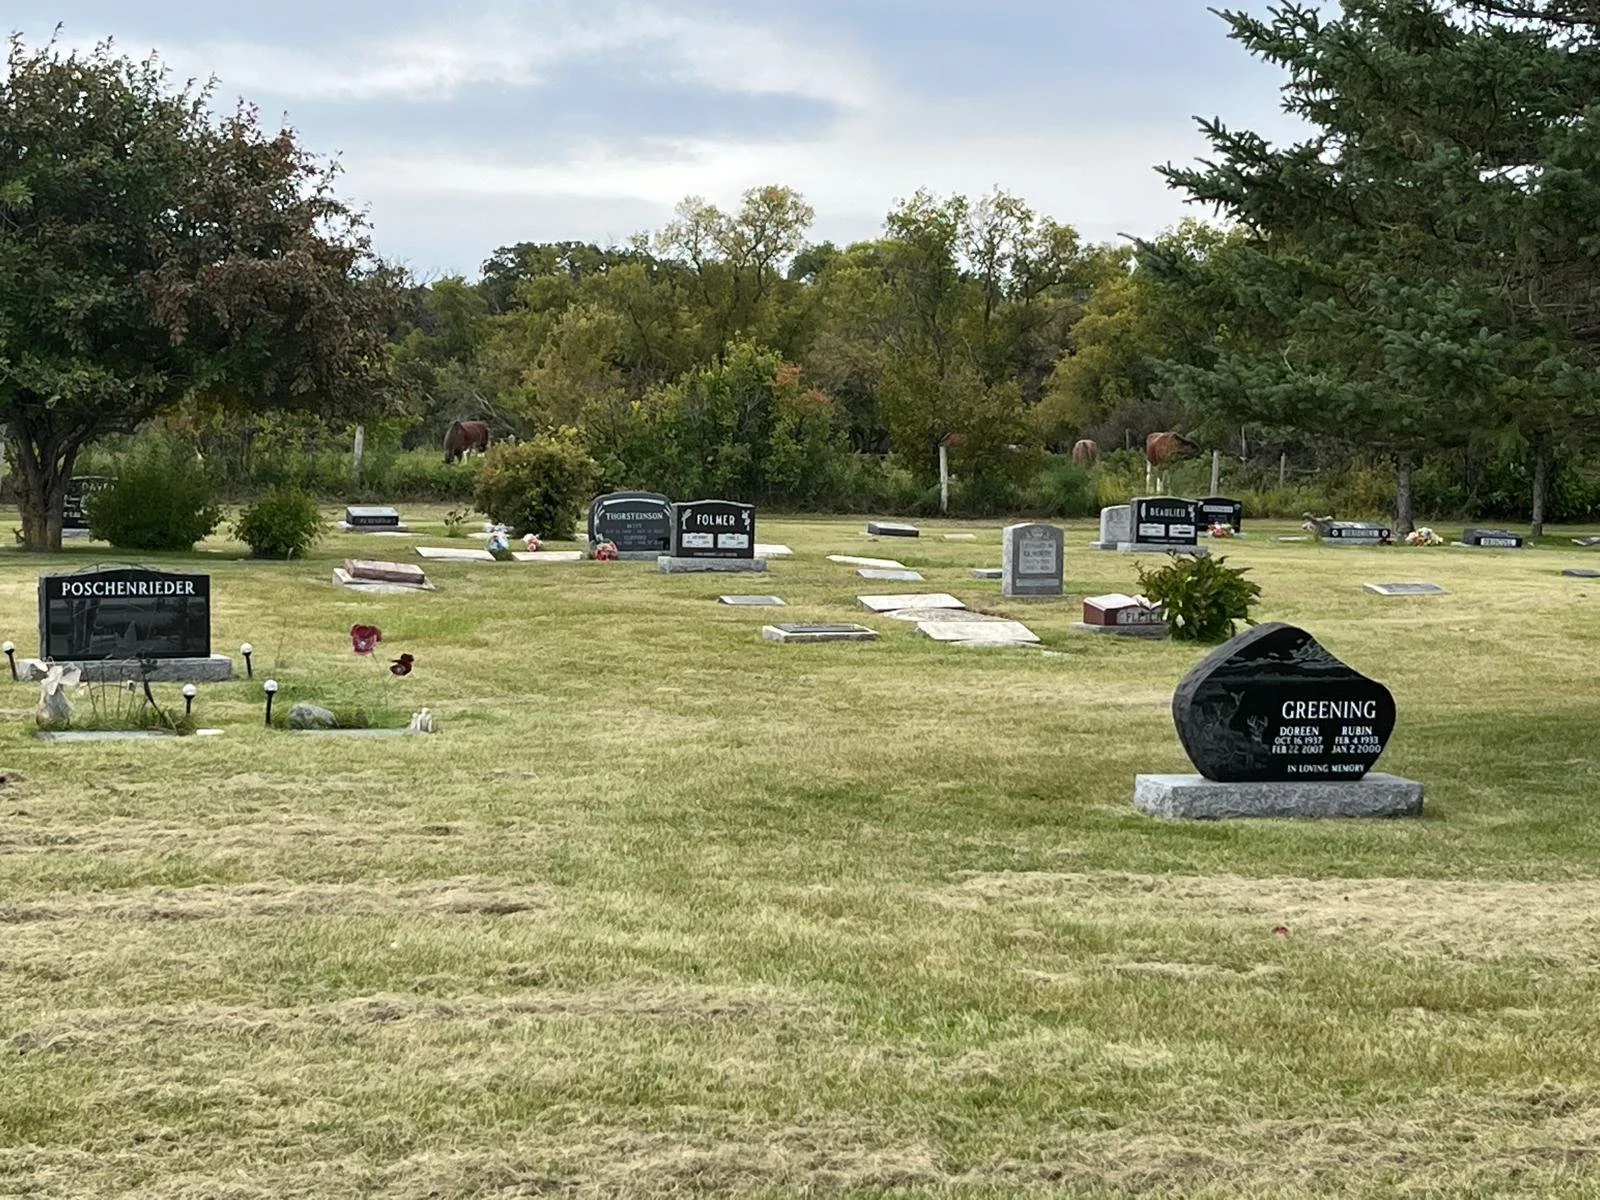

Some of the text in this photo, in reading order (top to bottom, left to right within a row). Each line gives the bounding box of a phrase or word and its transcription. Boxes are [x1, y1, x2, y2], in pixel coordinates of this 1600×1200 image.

[605, 512, 664, 520] THORSTEINSON
[1149, 507, 1186, 518] BEAULIEU
[696, 514, 735, 526] FOLMER
[61, 580, 196, 596] POSCHENRIEDER
[1282, 700, 1376, 719] GREENING
[1279, 726, 1320, 737] DOREEN
[1341, 726, 1373, 736] RUBIN
[1304, 736, 1324, 745] 1937
[1301, 745, 1324, 754] 2007
[1357, 745, 1382, 754] 2000
[1287, 764, 1366, 773] IN LOVING MEMORY
